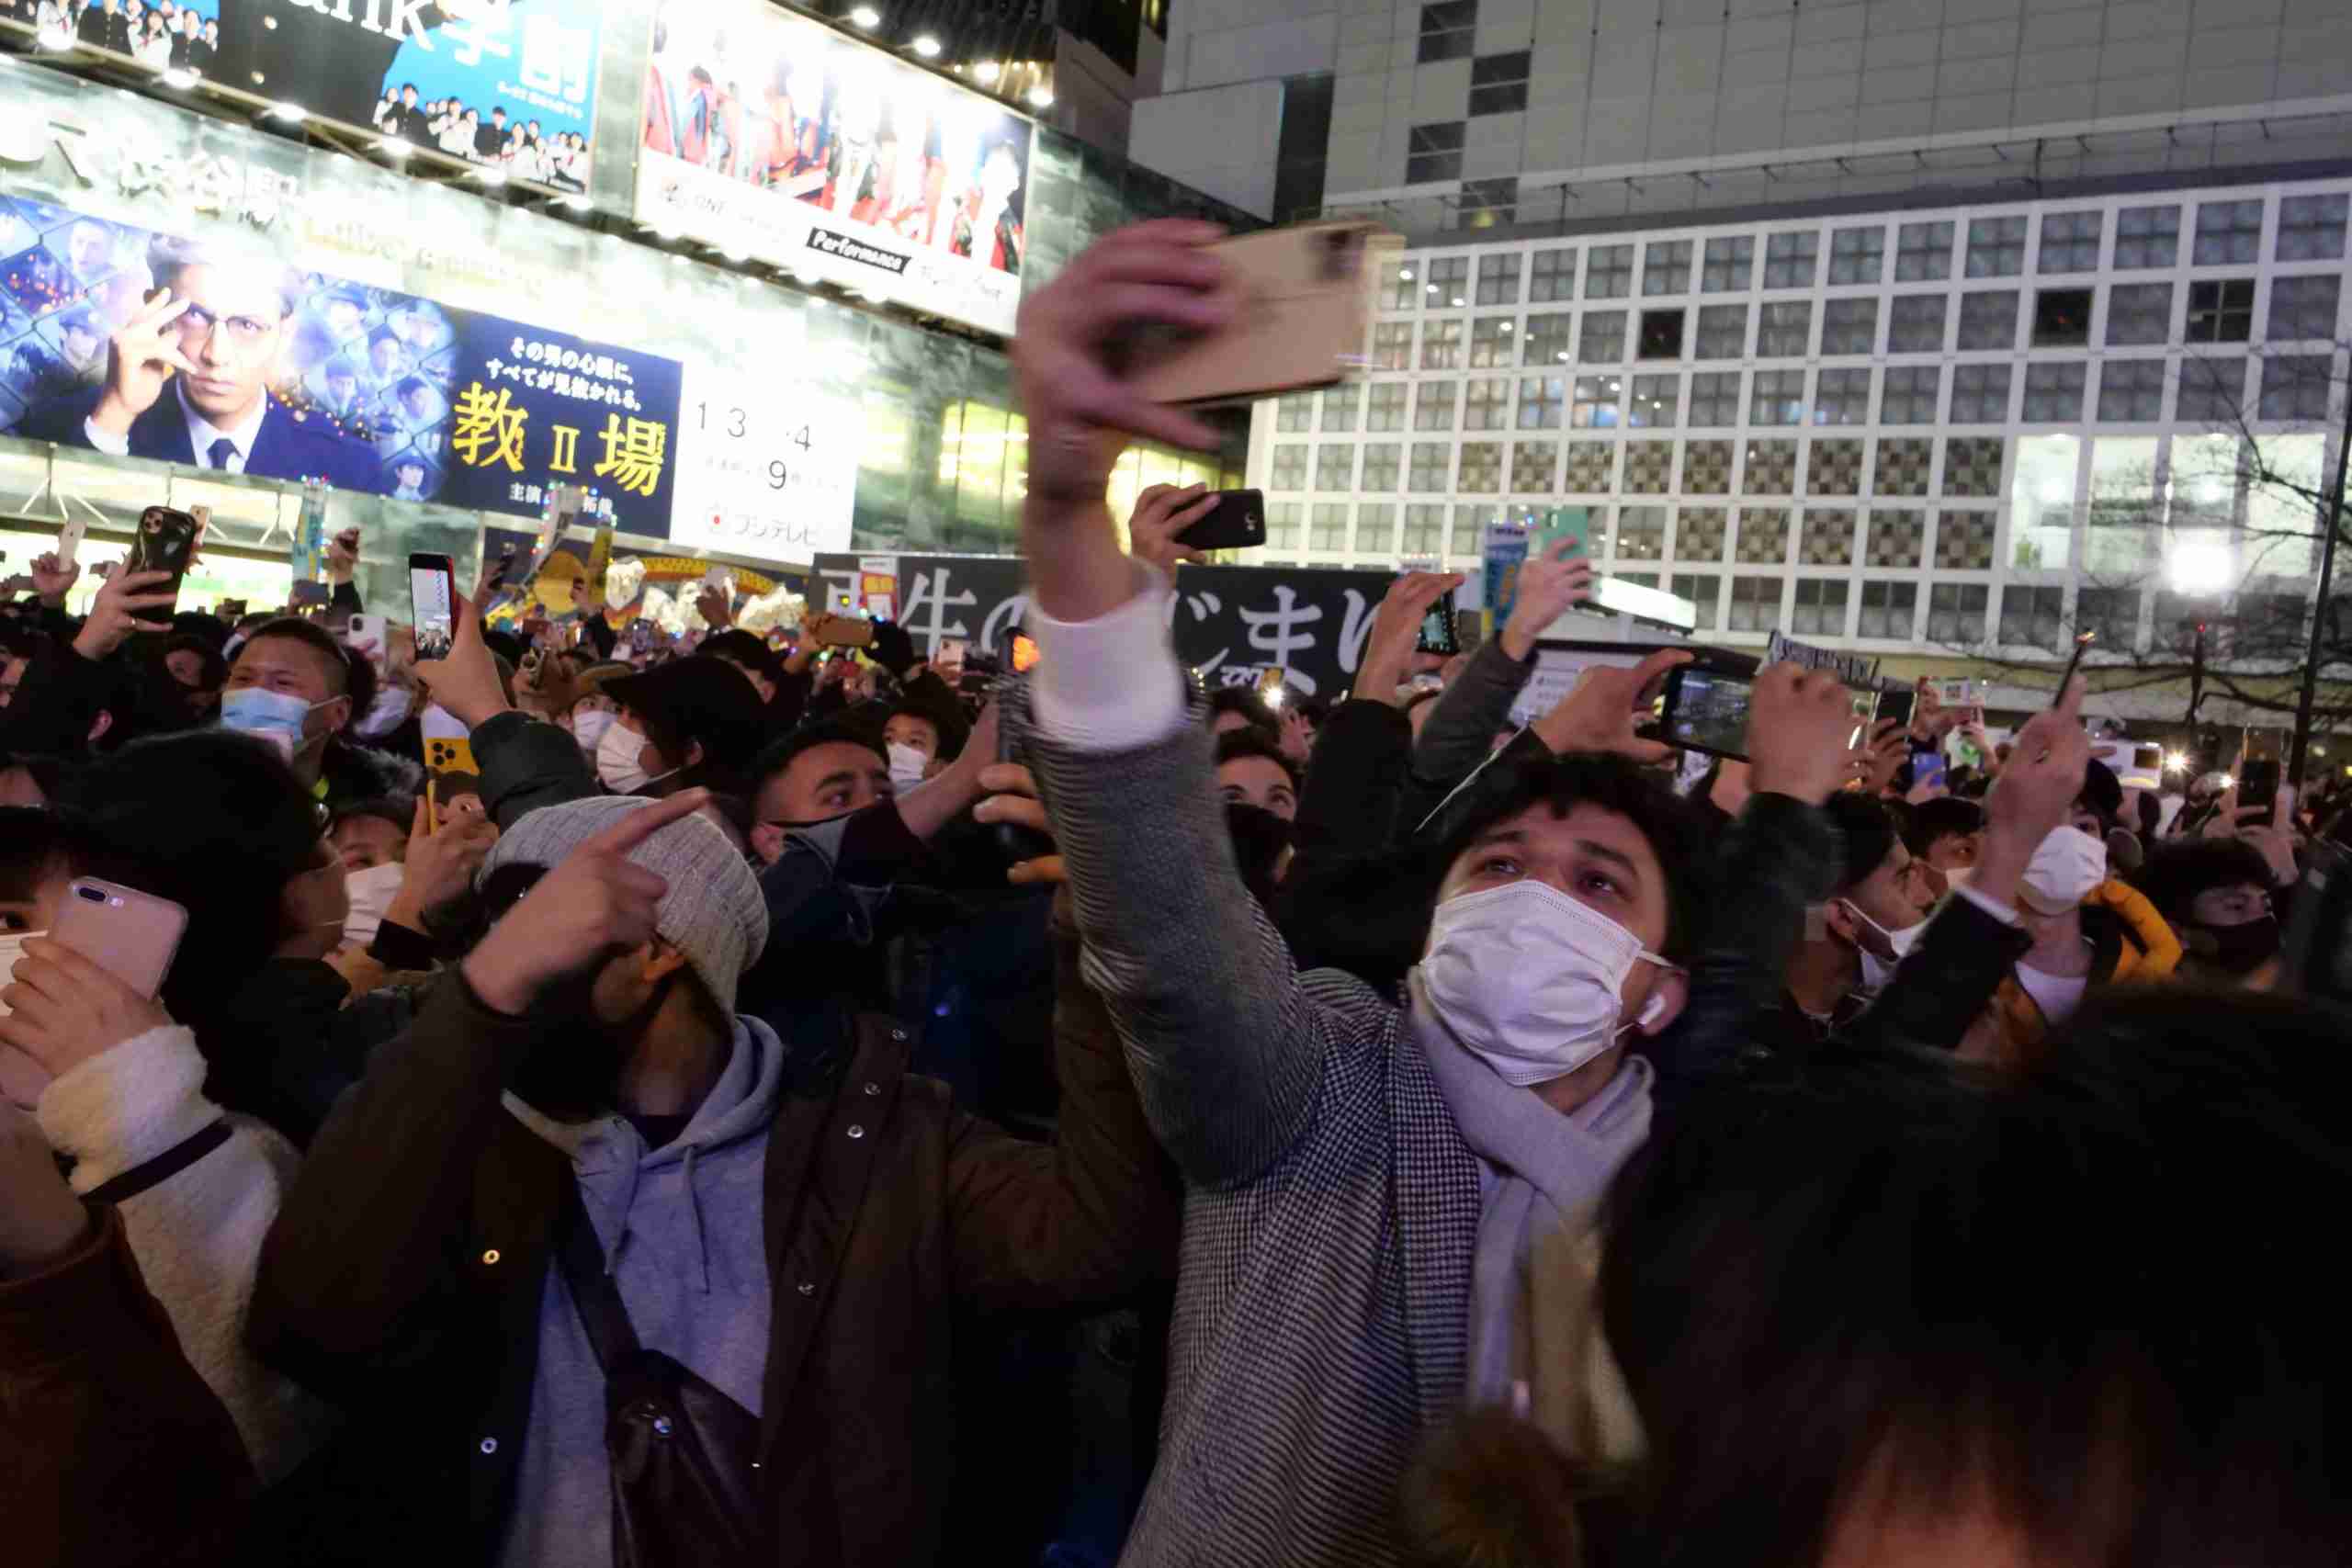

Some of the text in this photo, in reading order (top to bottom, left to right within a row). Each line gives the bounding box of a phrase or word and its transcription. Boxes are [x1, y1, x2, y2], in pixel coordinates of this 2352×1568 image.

[812, 230, 902, 271] Performance
[453, 381, 529, 472] 教
[594, 412, 667, 497] 場
